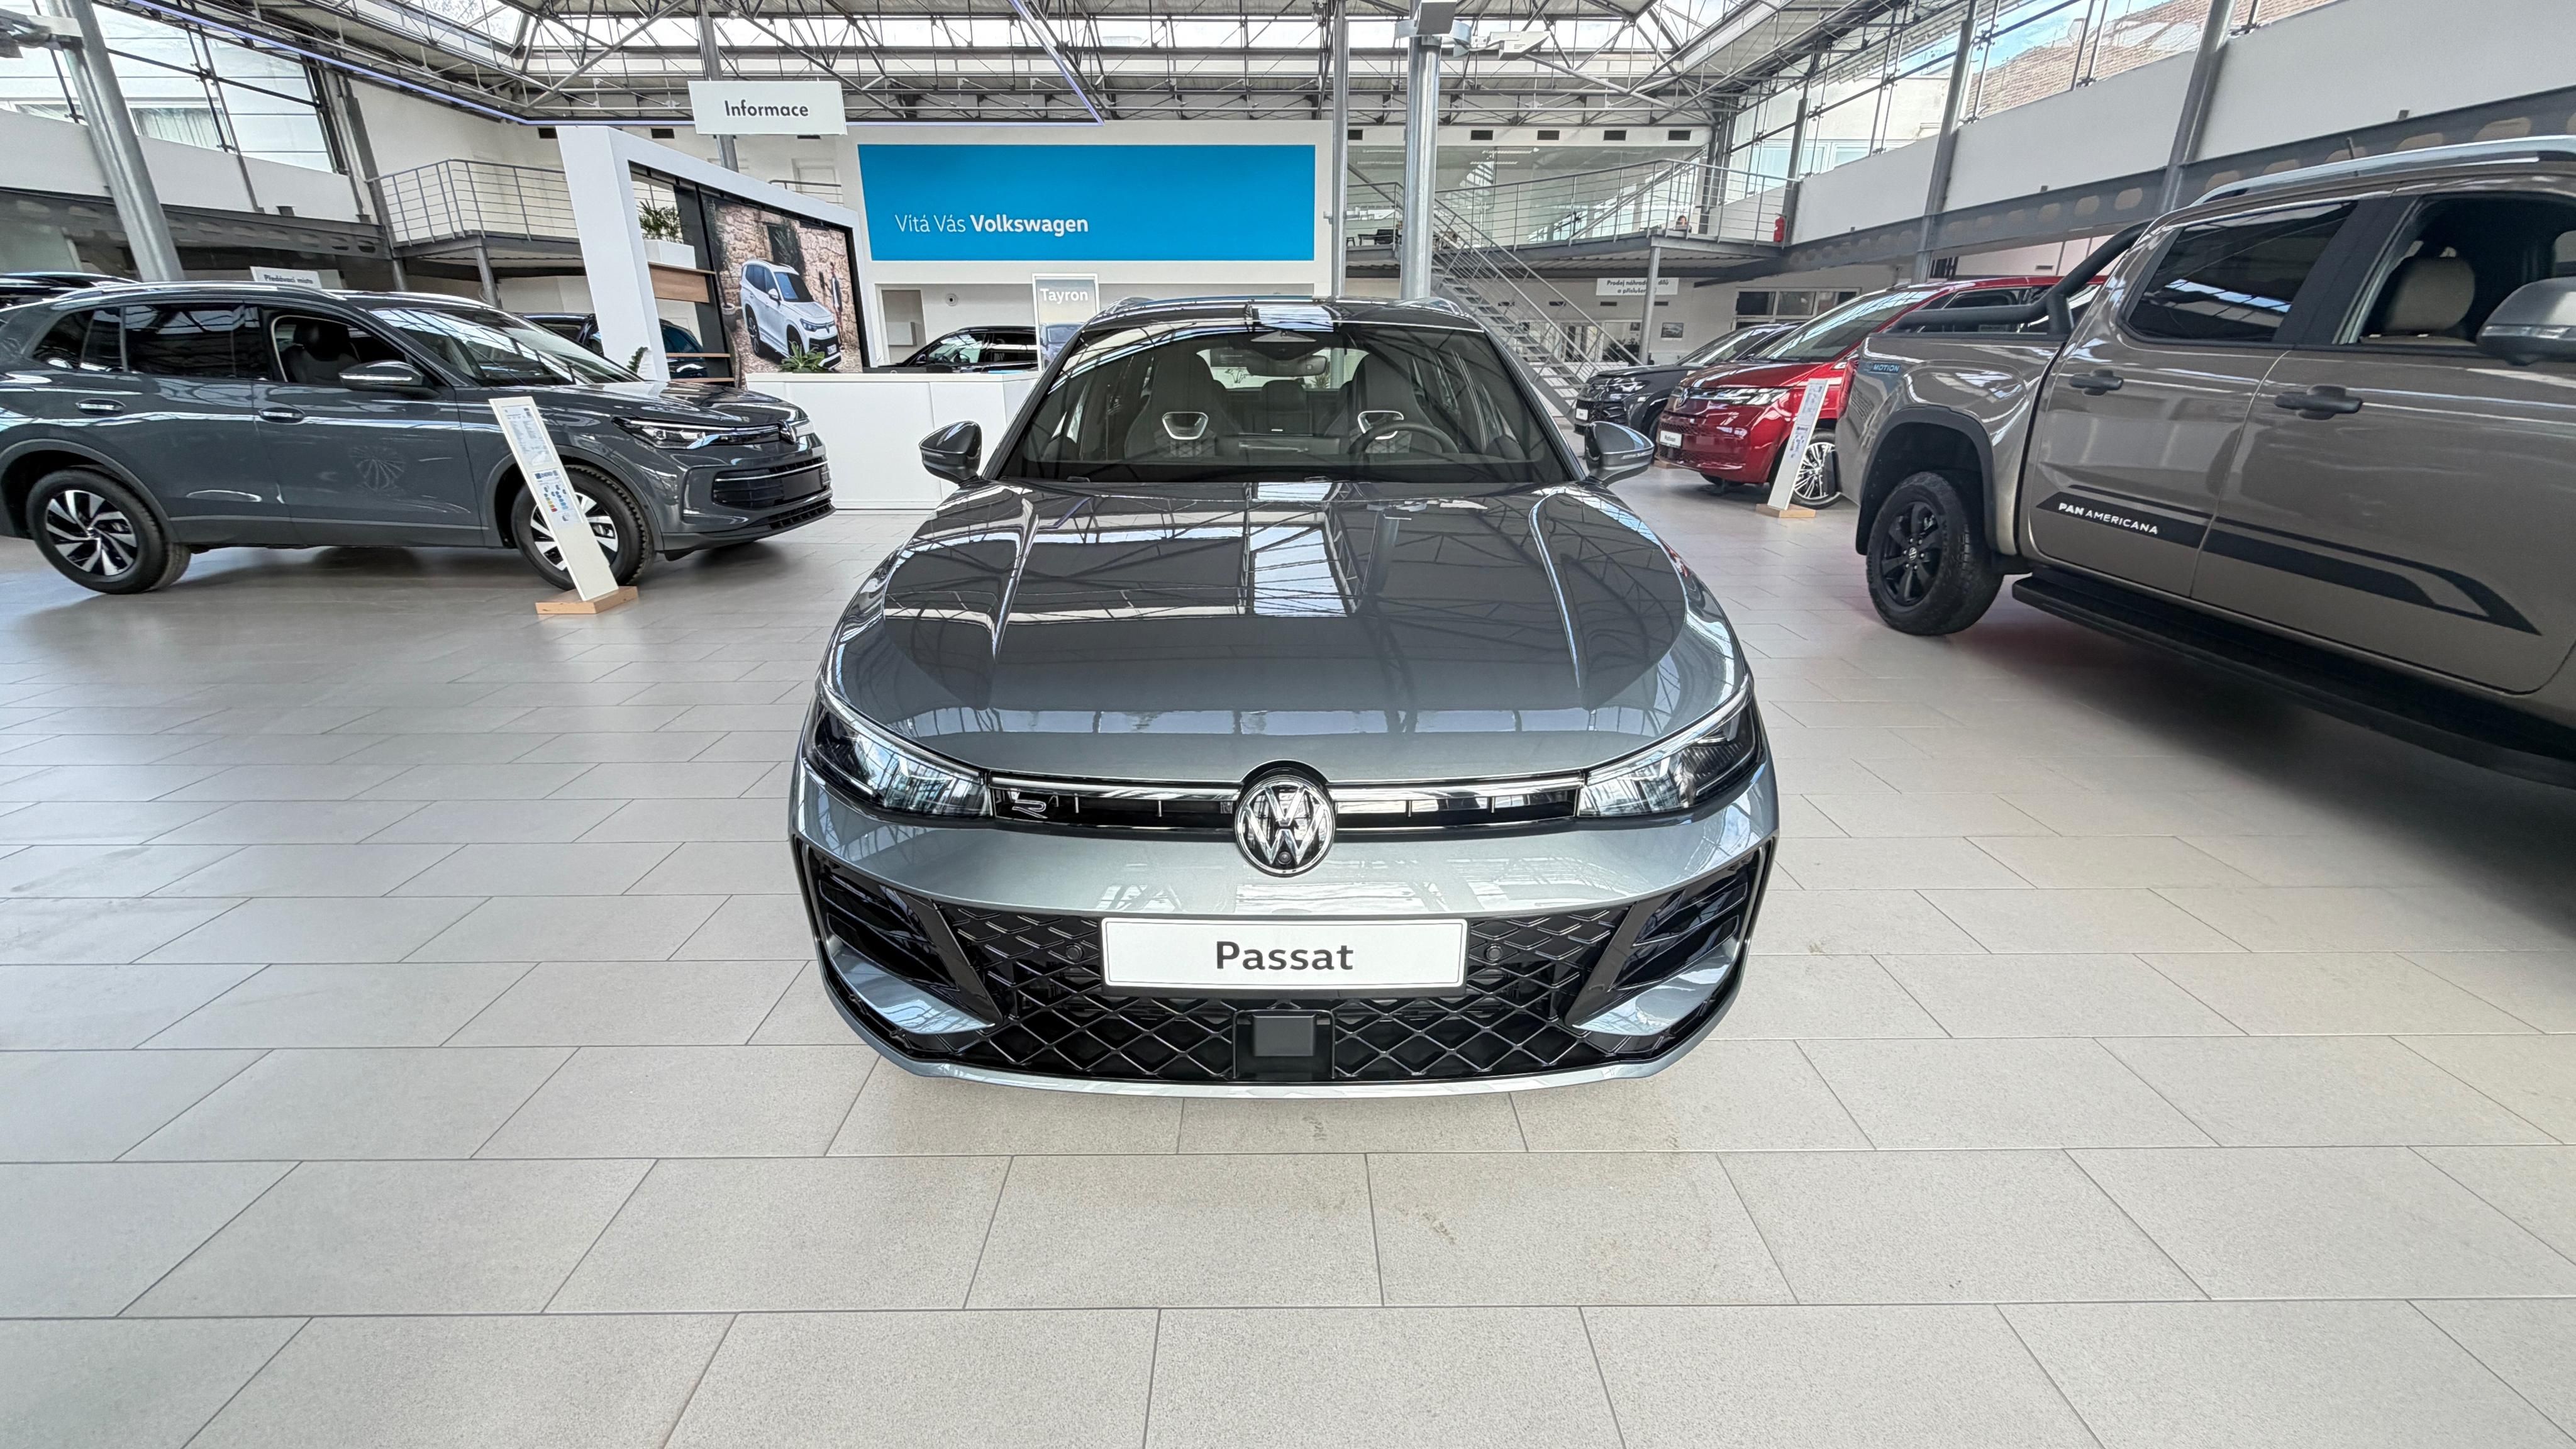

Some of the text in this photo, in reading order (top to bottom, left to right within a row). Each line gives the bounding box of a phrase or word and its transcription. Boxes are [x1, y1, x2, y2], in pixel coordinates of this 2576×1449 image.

[724, 99, 809, 116] Informace
[895, 214, 1089, 237] Vítá Vás Volkswagen
[1040, 288, 1089, 304] Tayron
[2058, 502, 2158, 535] PAN AMERICANA
[1216, 941, 1354, 970] Passat
